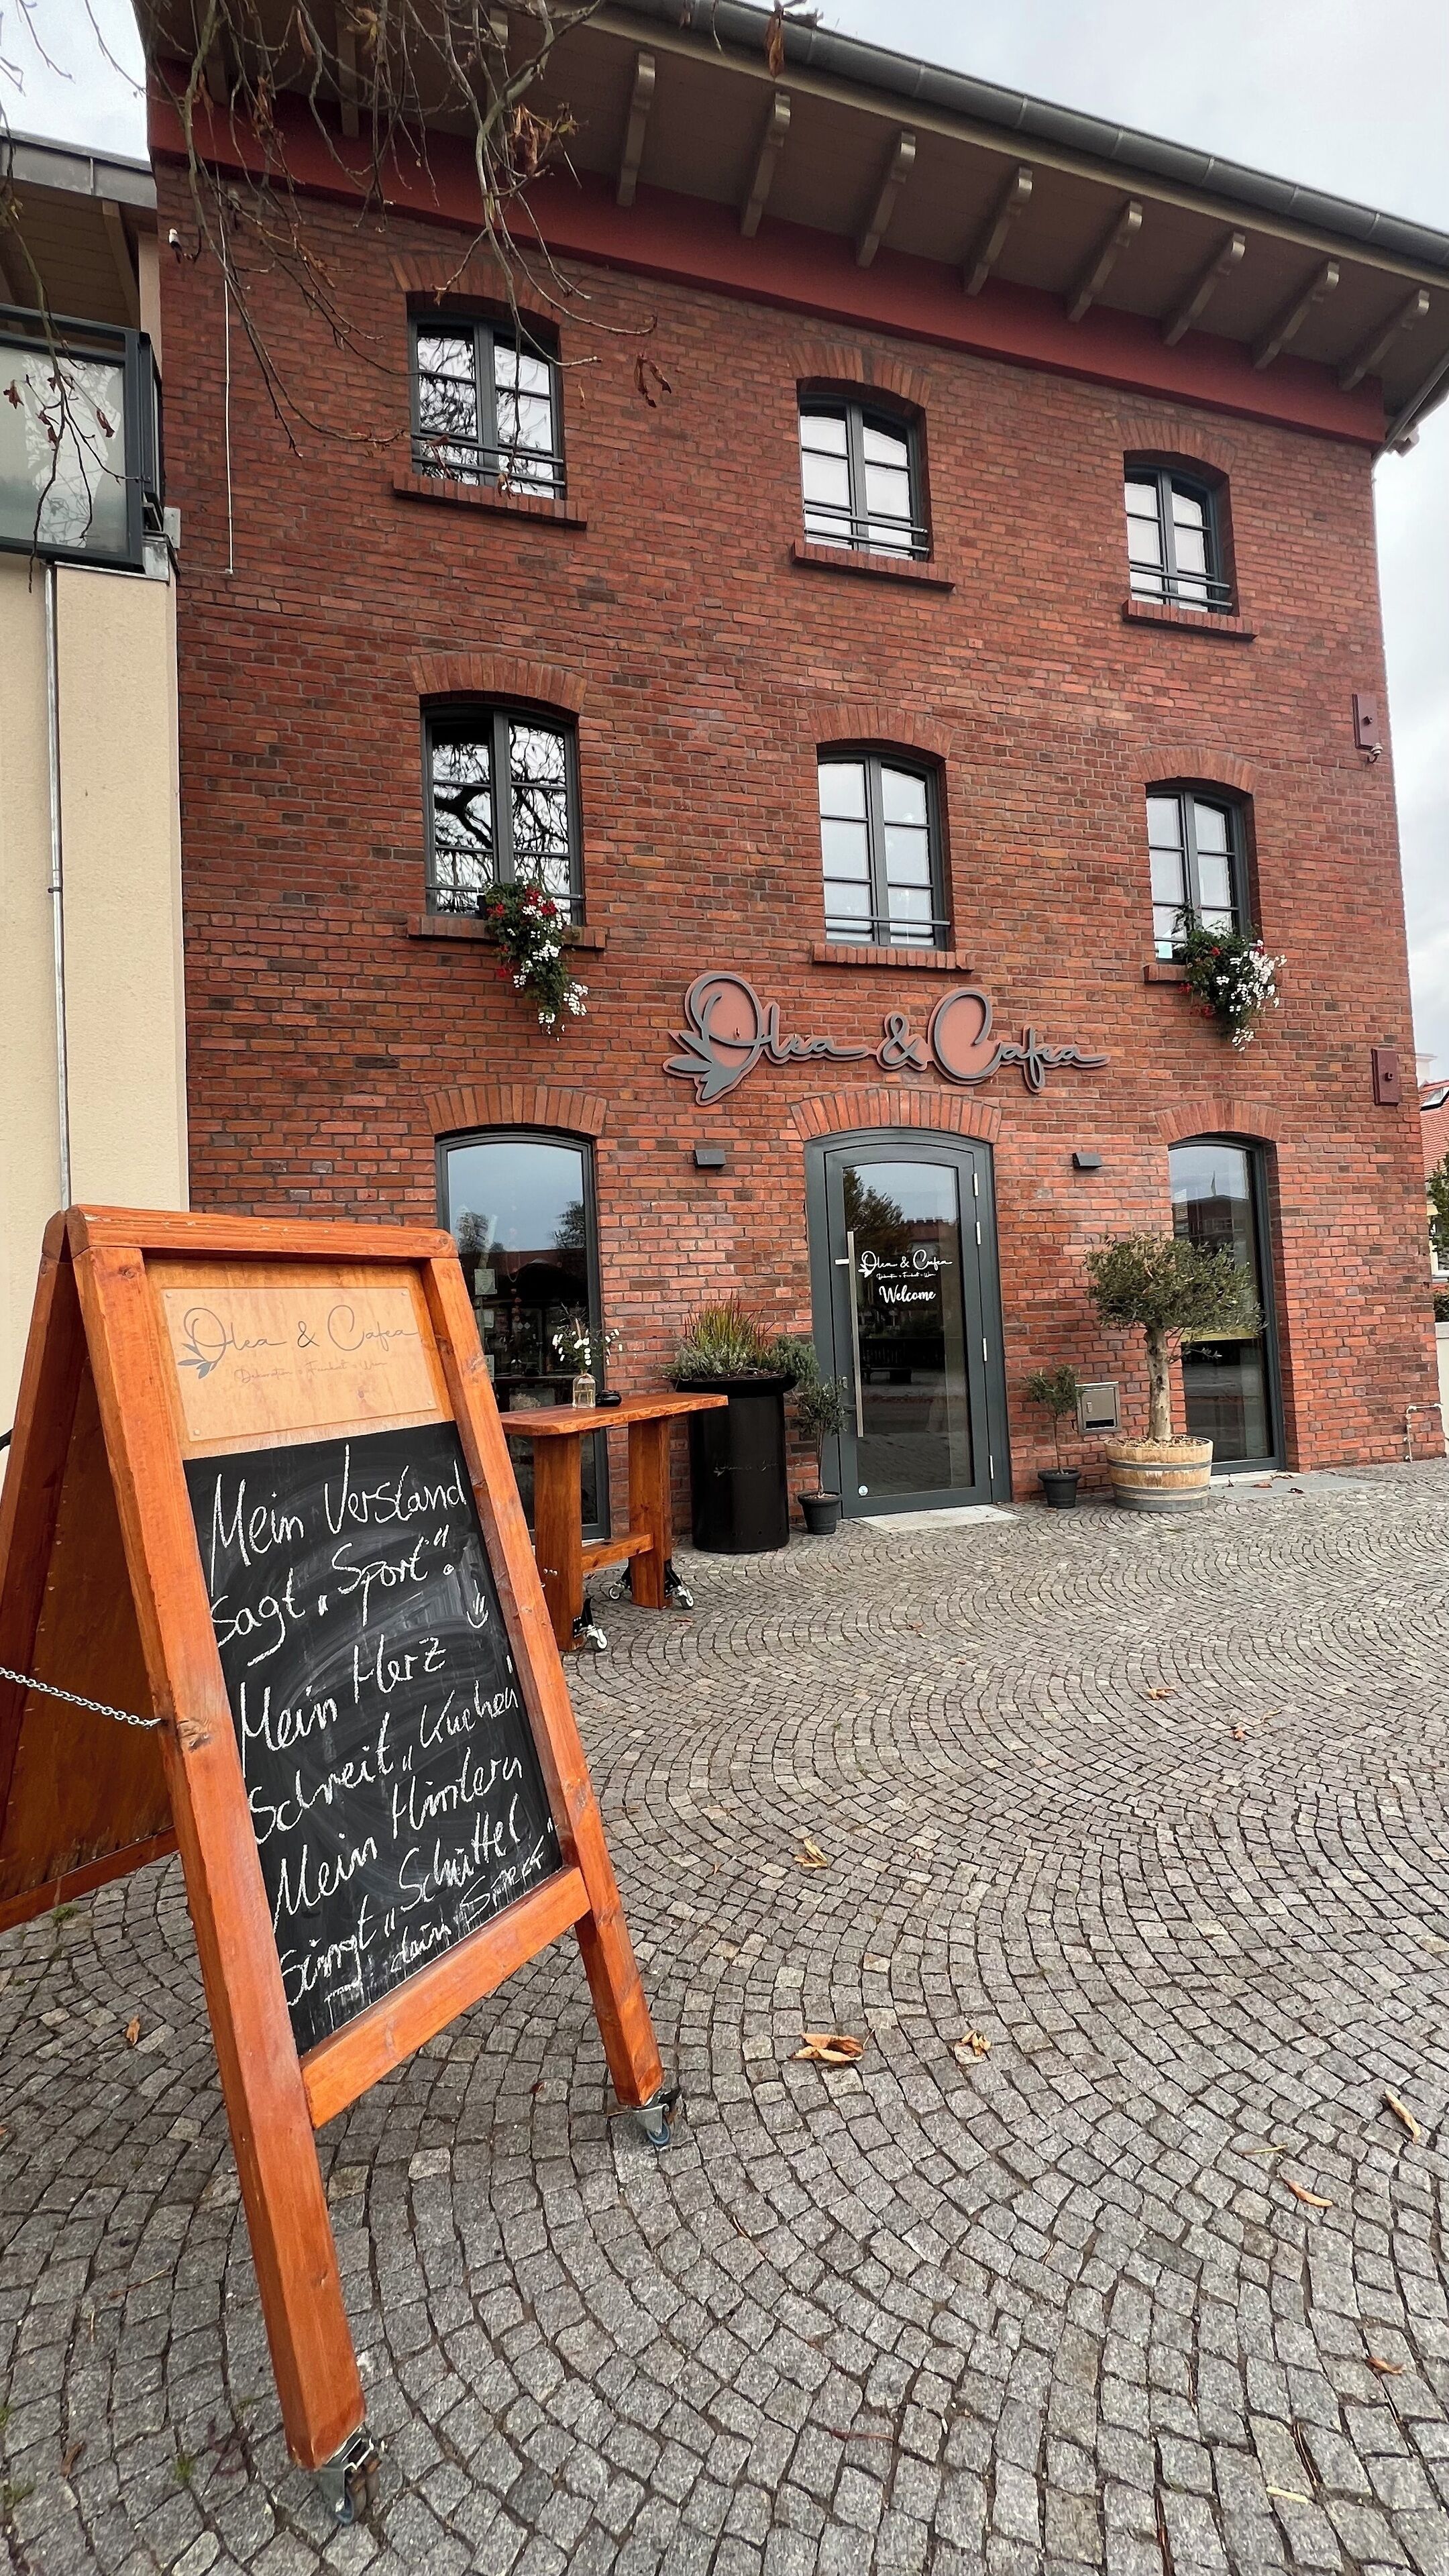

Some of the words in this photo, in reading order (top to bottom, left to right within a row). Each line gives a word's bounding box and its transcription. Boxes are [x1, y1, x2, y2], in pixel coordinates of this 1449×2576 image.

[684, 971, 873, 1079] Olea
[877, 1012, 928, 1071] &
[931, 987, 1111, 1093] Cafea
[861, 1250, 898, 1272] Olea
[900, 1256, 910, 1268] &
[879, 1284, 936, 1303] Welcome
[183, 1307, 287, 1365] Olea
[297, 1321, 320, 1348] &
[327, 1305, 419, 1352] Cafea
[211, 1474, 304, 1597] Mein
[325, 1444, 467, 1534] Verstand
[240, 1681, 337, 1778] Mein
[354, 1633, 447, 1704] Herz
[274, 1834, 378, 1935] Mein
[392, 1747, 523, 1839] Hintern
